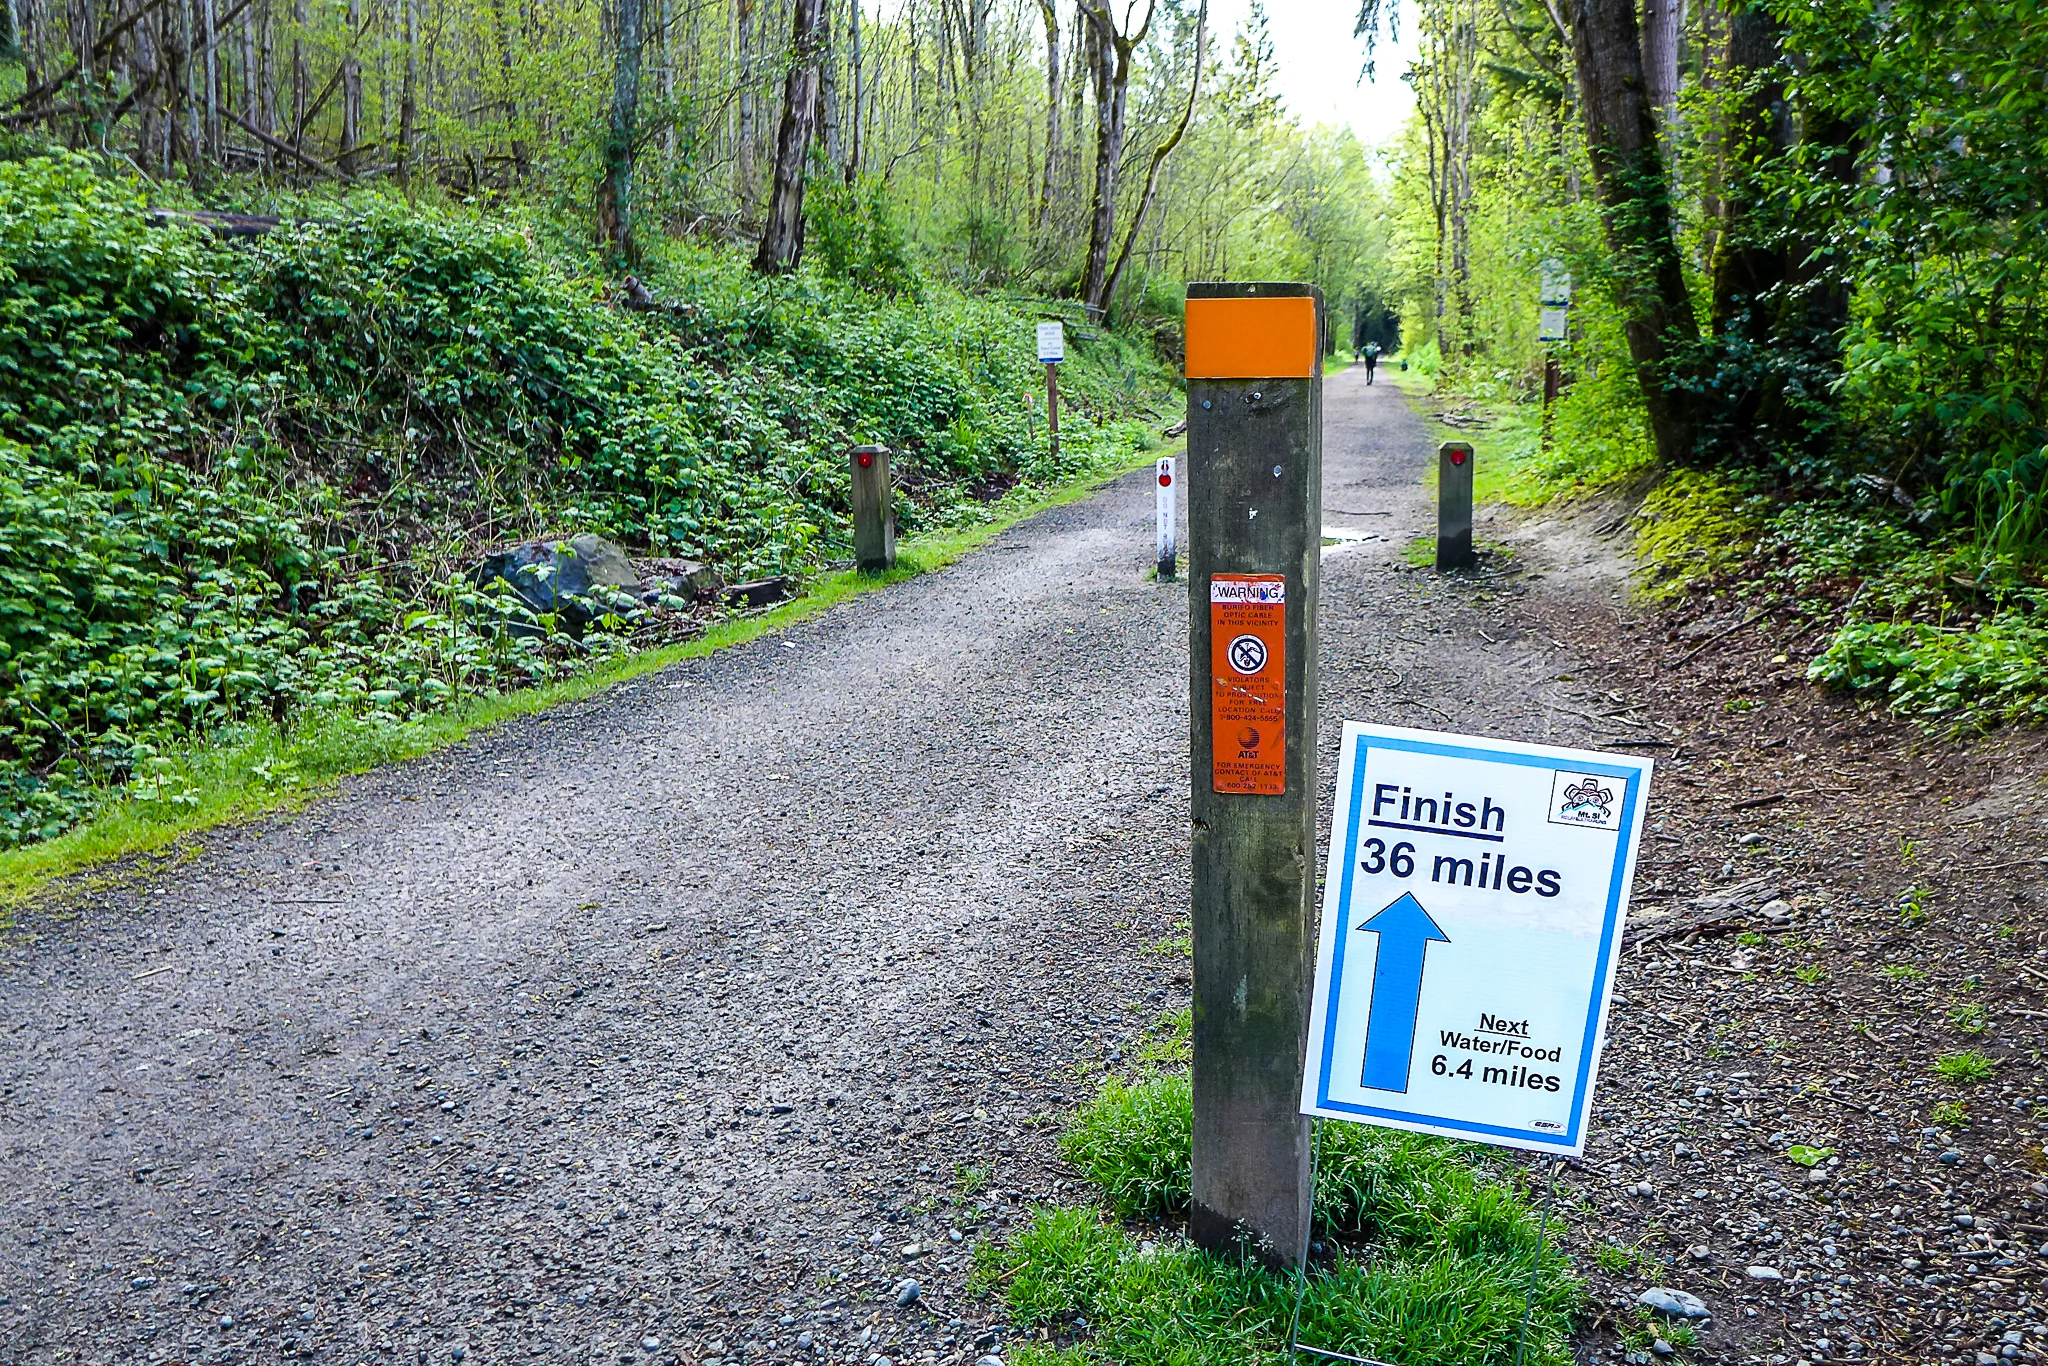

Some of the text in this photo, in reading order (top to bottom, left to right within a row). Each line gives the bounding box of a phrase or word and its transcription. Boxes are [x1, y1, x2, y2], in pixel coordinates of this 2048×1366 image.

[1217, 587, 1279, 598] WARNING
[1234, 762, 1280, 770] EMERGENCY
[1238, 751, 1259, 759] AT&T
[1372, 783, 1505, 832] Finish
[1360, 837, 1562, 898] 36 miles
[1479, 1013, 1529, 1036] Next
[1440, 1030, 1562, 1063] Water/Food
[1431, 1054, 1561, 1093] 6.4 miles
